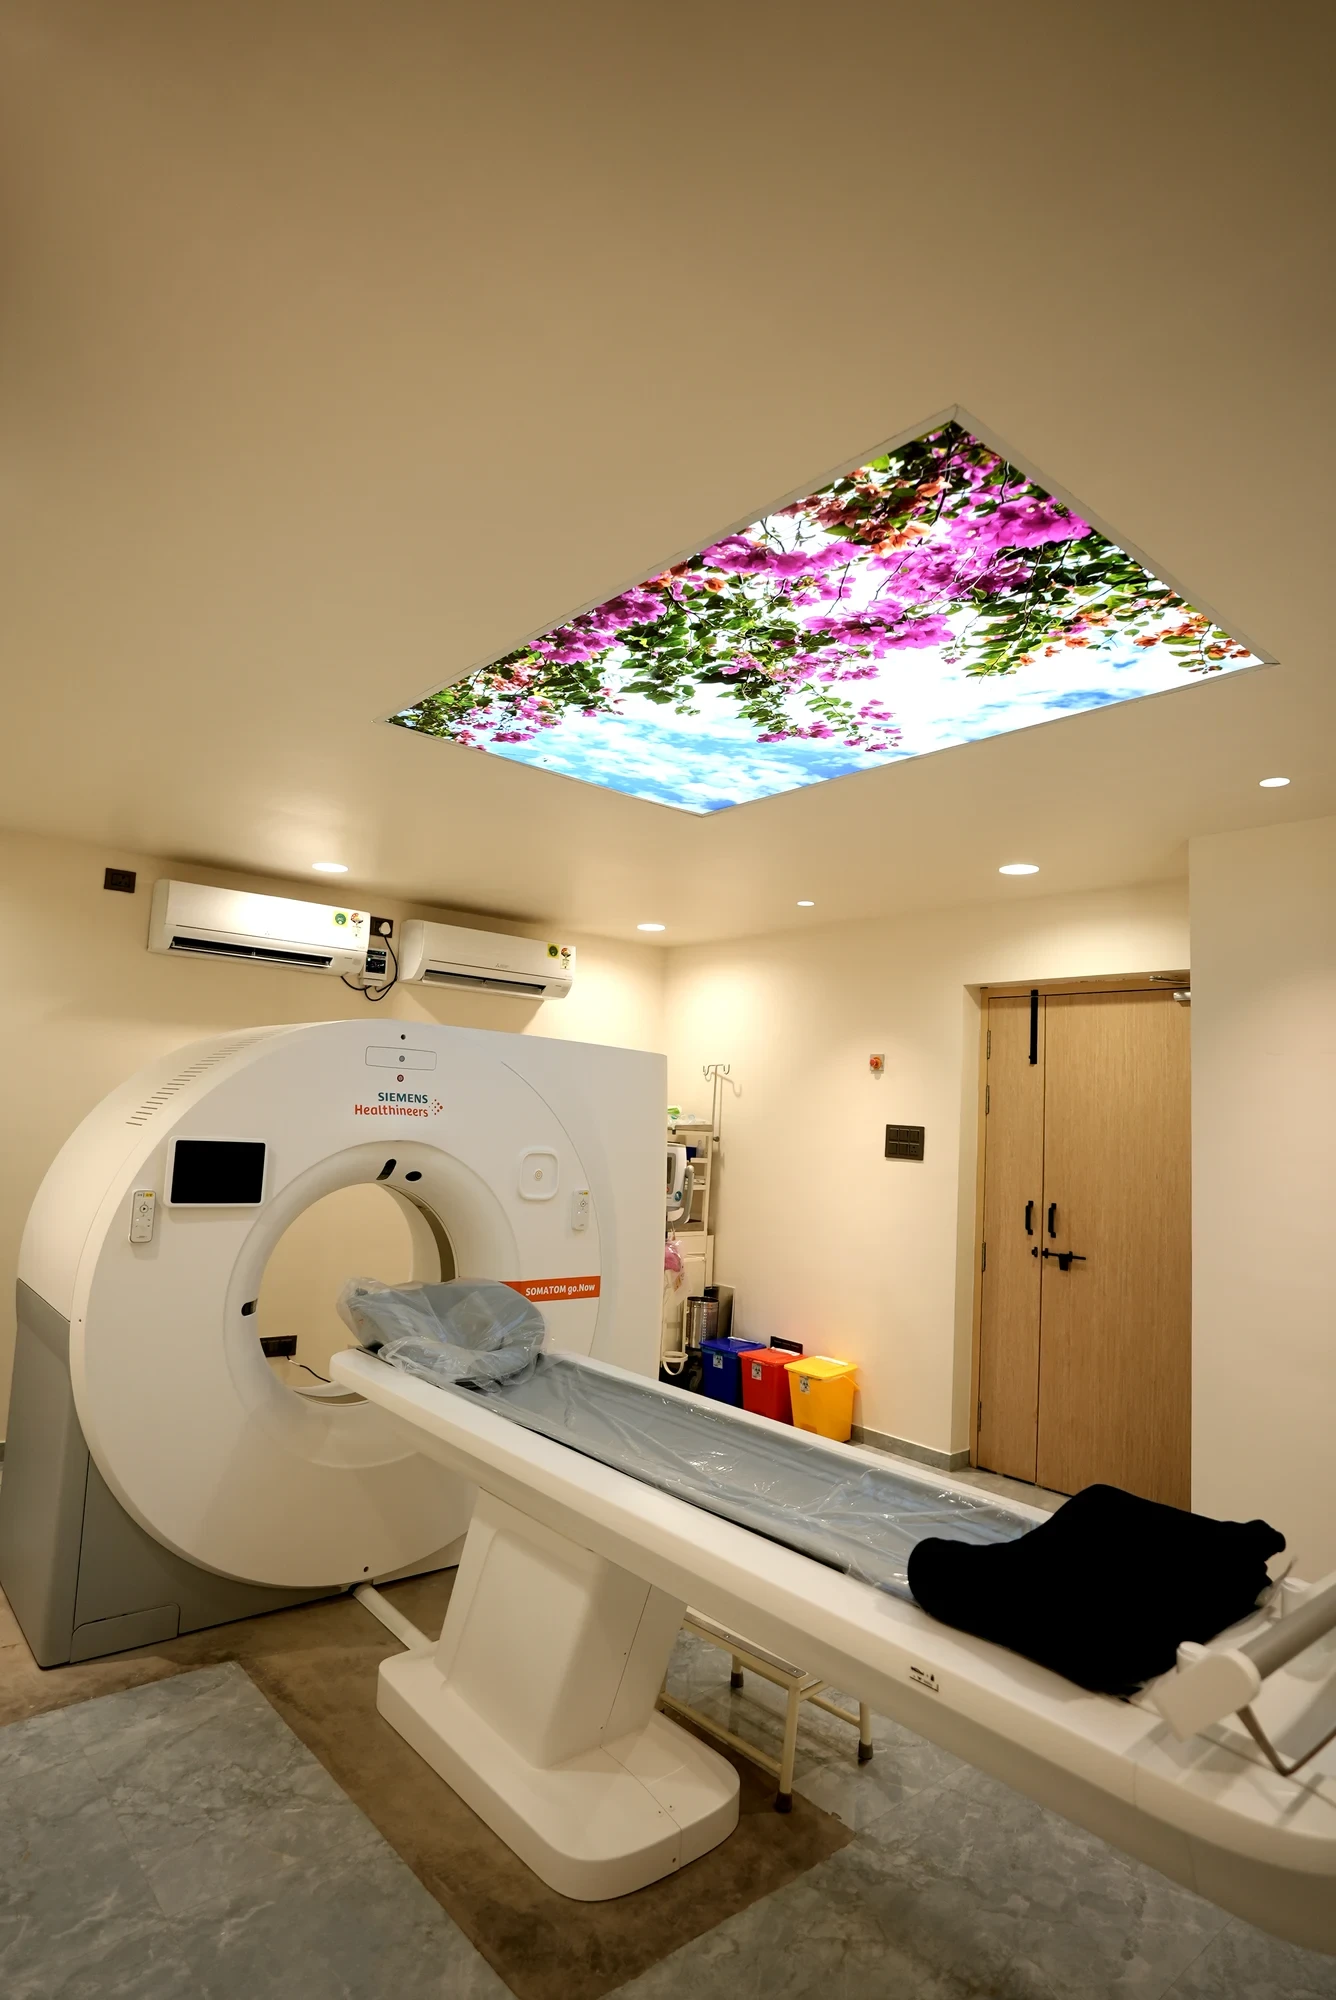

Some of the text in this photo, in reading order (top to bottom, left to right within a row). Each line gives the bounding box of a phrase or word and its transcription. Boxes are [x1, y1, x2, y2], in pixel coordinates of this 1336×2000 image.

[377, 1092, 429, 1104] SIEMENS
[354, 1104, 429, 1118] Healthineers
[525, 1283, 596, 1296] SOMATOM go.Now
